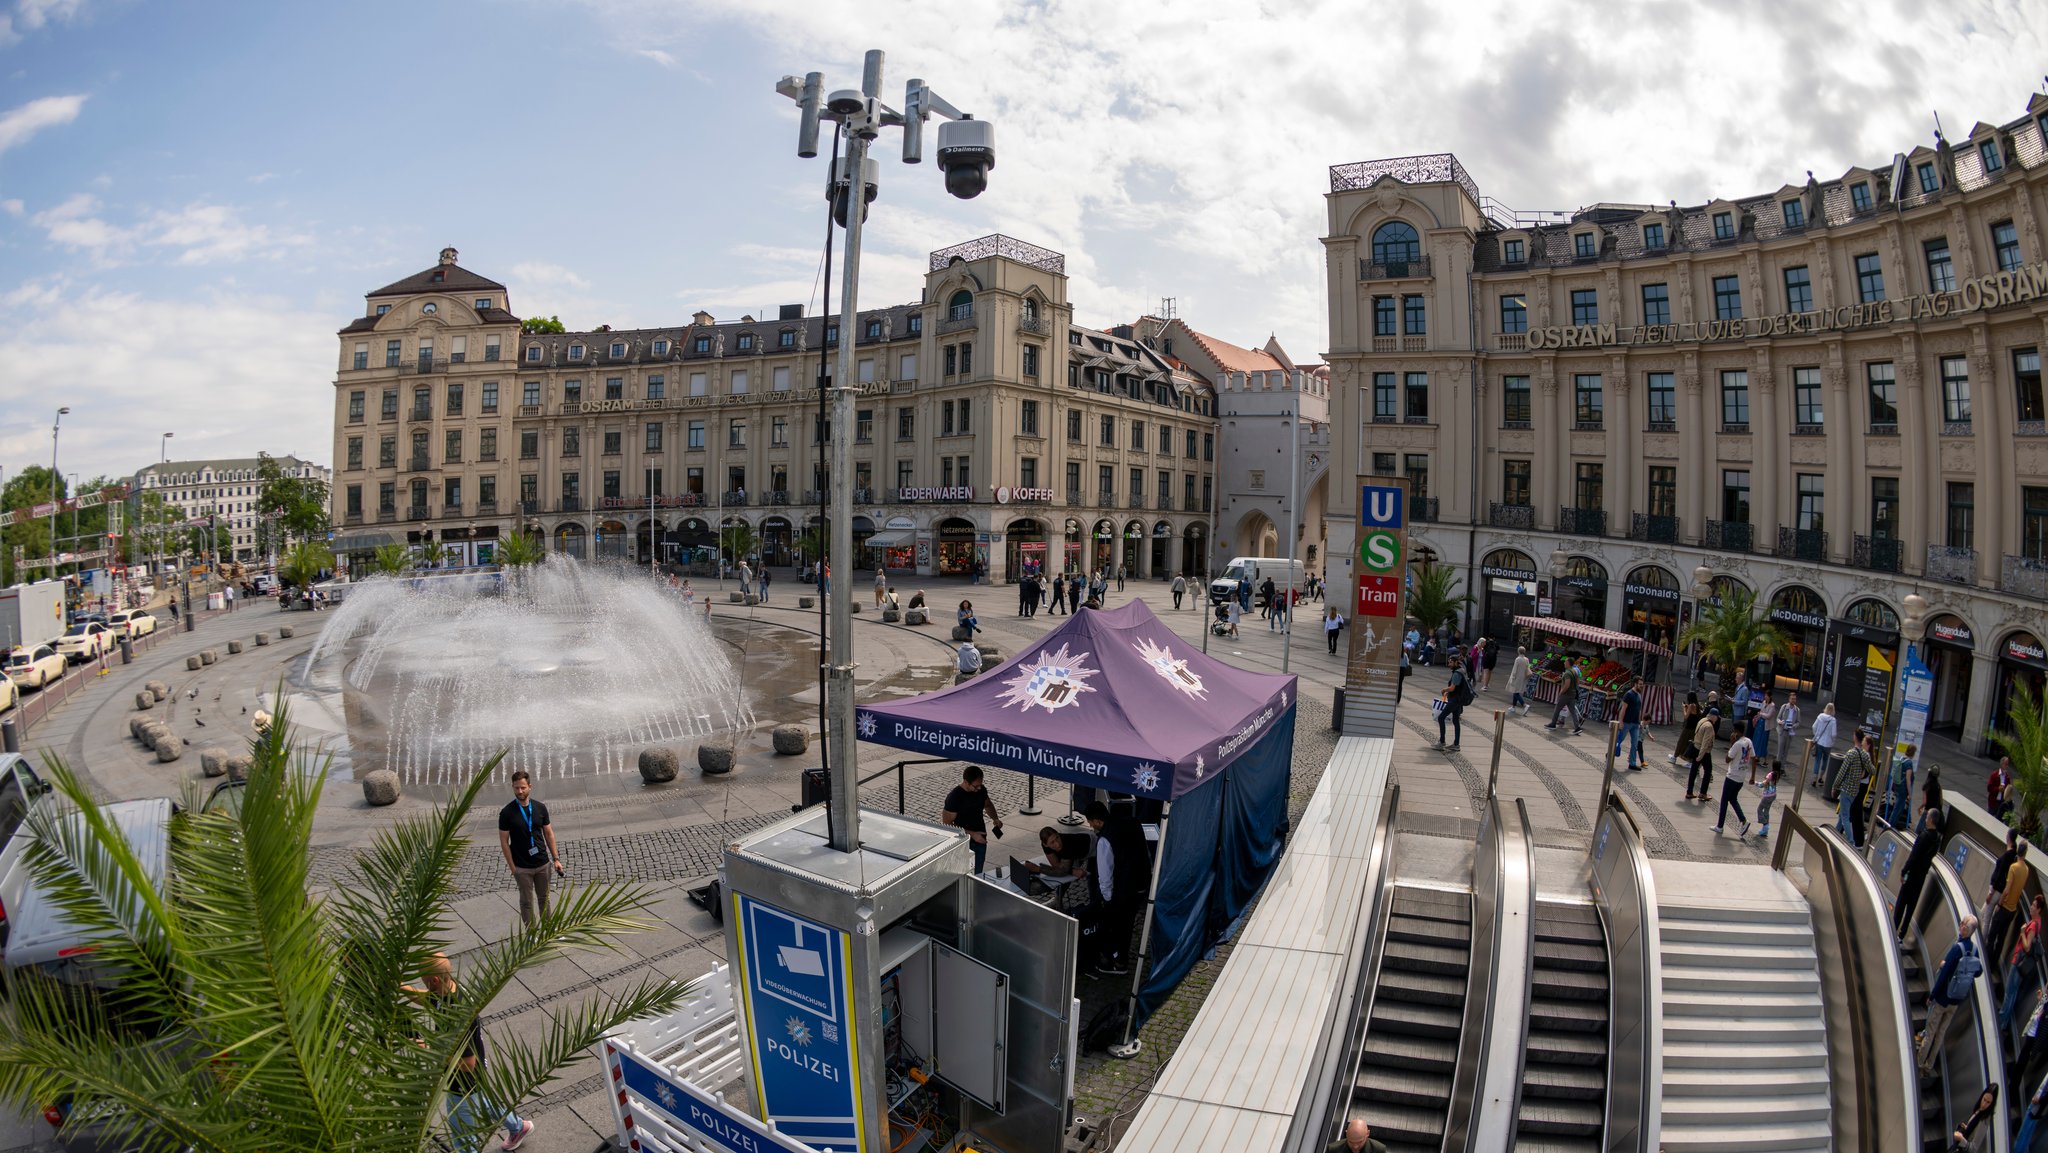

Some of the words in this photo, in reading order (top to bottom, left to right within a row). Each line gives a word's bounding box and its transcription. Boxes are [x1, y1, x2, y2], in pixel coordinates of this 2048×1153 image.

[1526, 322, 1617, 349] OSRAM
[1631, 323, 1683, 345] HELL
[1694, 317, 1746, 341] WIE
[1758, 313, 1805, 337] DER
[1819, 300, 1895, 331] LICHTE
[1904, 290, 1950, 319] TAG
[1961, 261, 2048, 312] OSRAM
[580, 398, 635, 413] OSRAM
[899, 486, 973, 500] LEDERWAREN
[1012, 487, 1054, 501] KOFFER
[1370, 490, 1394, 522] U
[1367, 534, 1394, 569] S
[1482, 566, 1535, 580] McDonald's
[1359, 586, 1397, 603] Tram
[1625, 584, 1679, 600] McDonald's
[1771, 608, 1825, 627] McDonald's
[1935, 622, 1970, 640] Hugendubel
[2009, 640, 2044, 659] Hugendubel
[1366, 667, 1388, 676] Stachus
[1218, 725, 1255, 760] Polizeipräsidium
[1253, 707, 1274, 732] München
[895, 722, 1022, 760] Polizeipräsidium
[1028, 746, 1109, 778] München
[765, 978, 827, 1009] VIDEOÜBERWACHUNG
[767, 1037, 839, 1083] POLIZEI
[690, 1104, 759, 1153] POLIZEI
